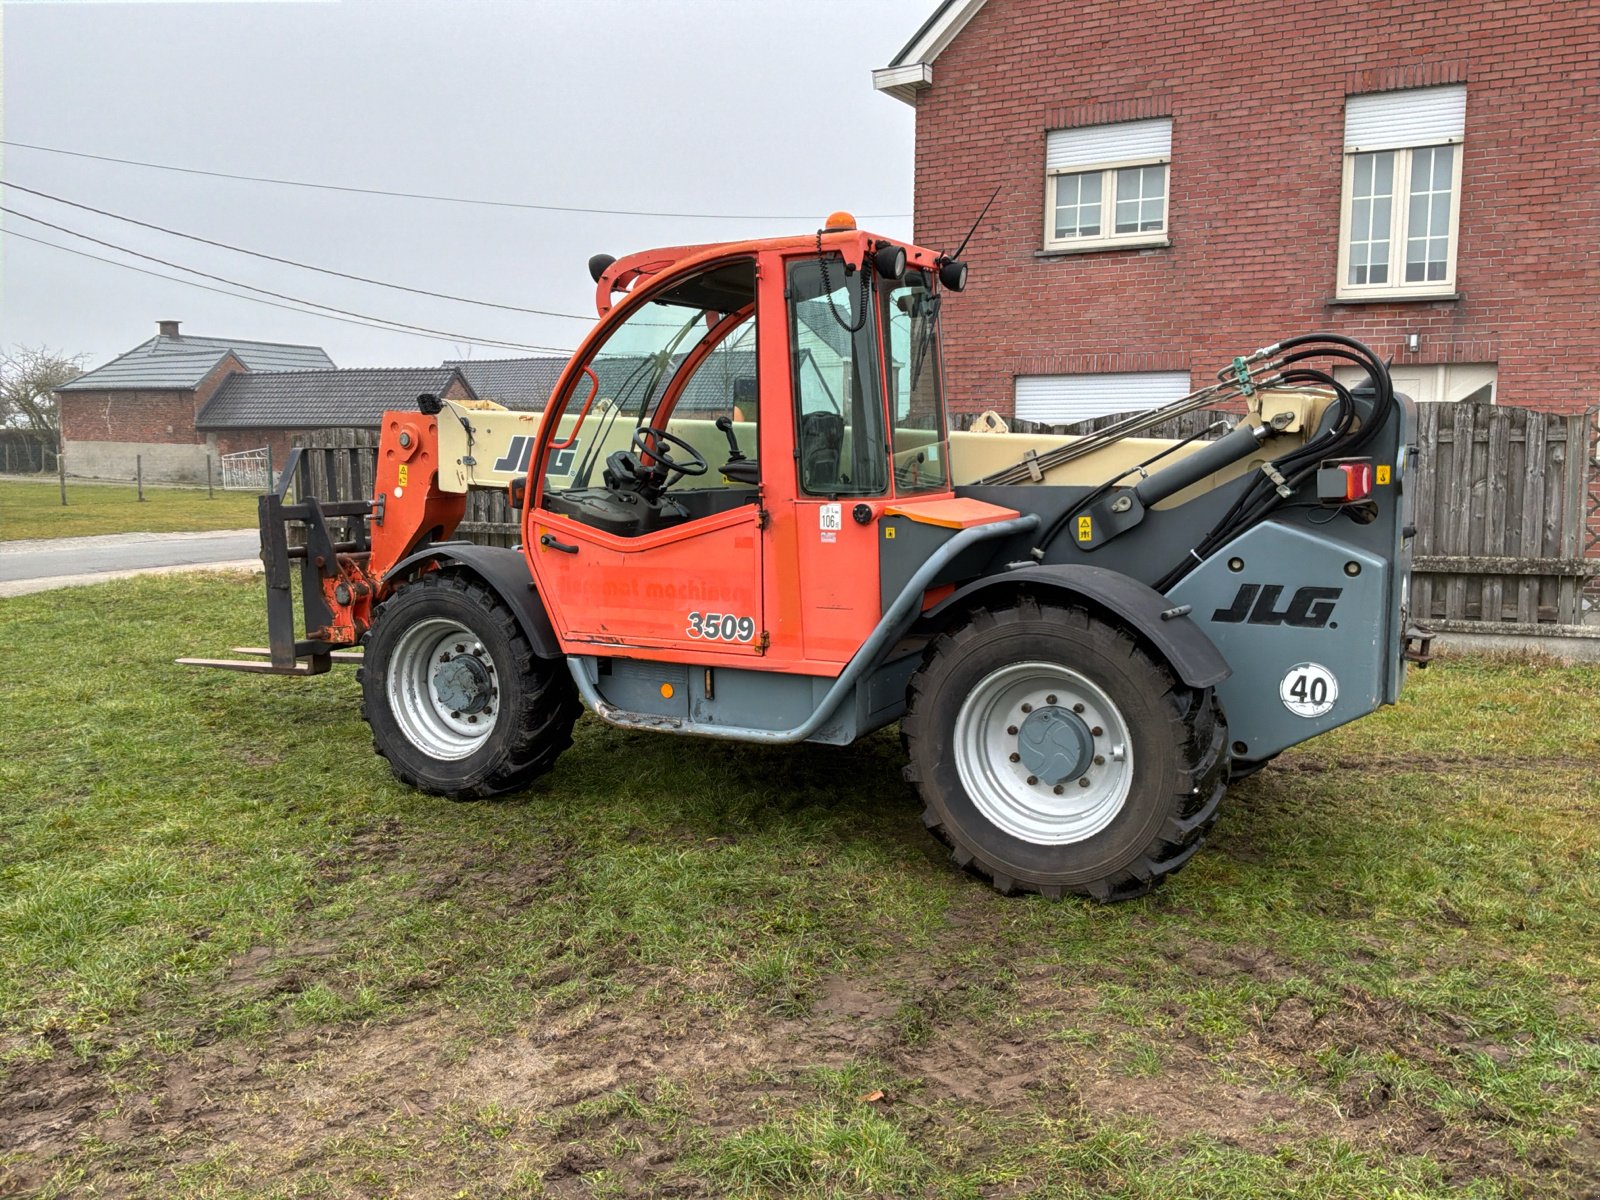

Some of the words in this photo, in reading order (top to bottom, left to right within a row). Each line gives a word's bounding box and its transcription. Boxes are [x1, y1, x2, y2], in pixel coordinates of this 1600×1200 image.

[822, 514, 835, 528] 106
[1211, 583, 1343, 629] JLG
[685, 611, 755, 643] 3509
[1290, 675, 1327, 706] 40
